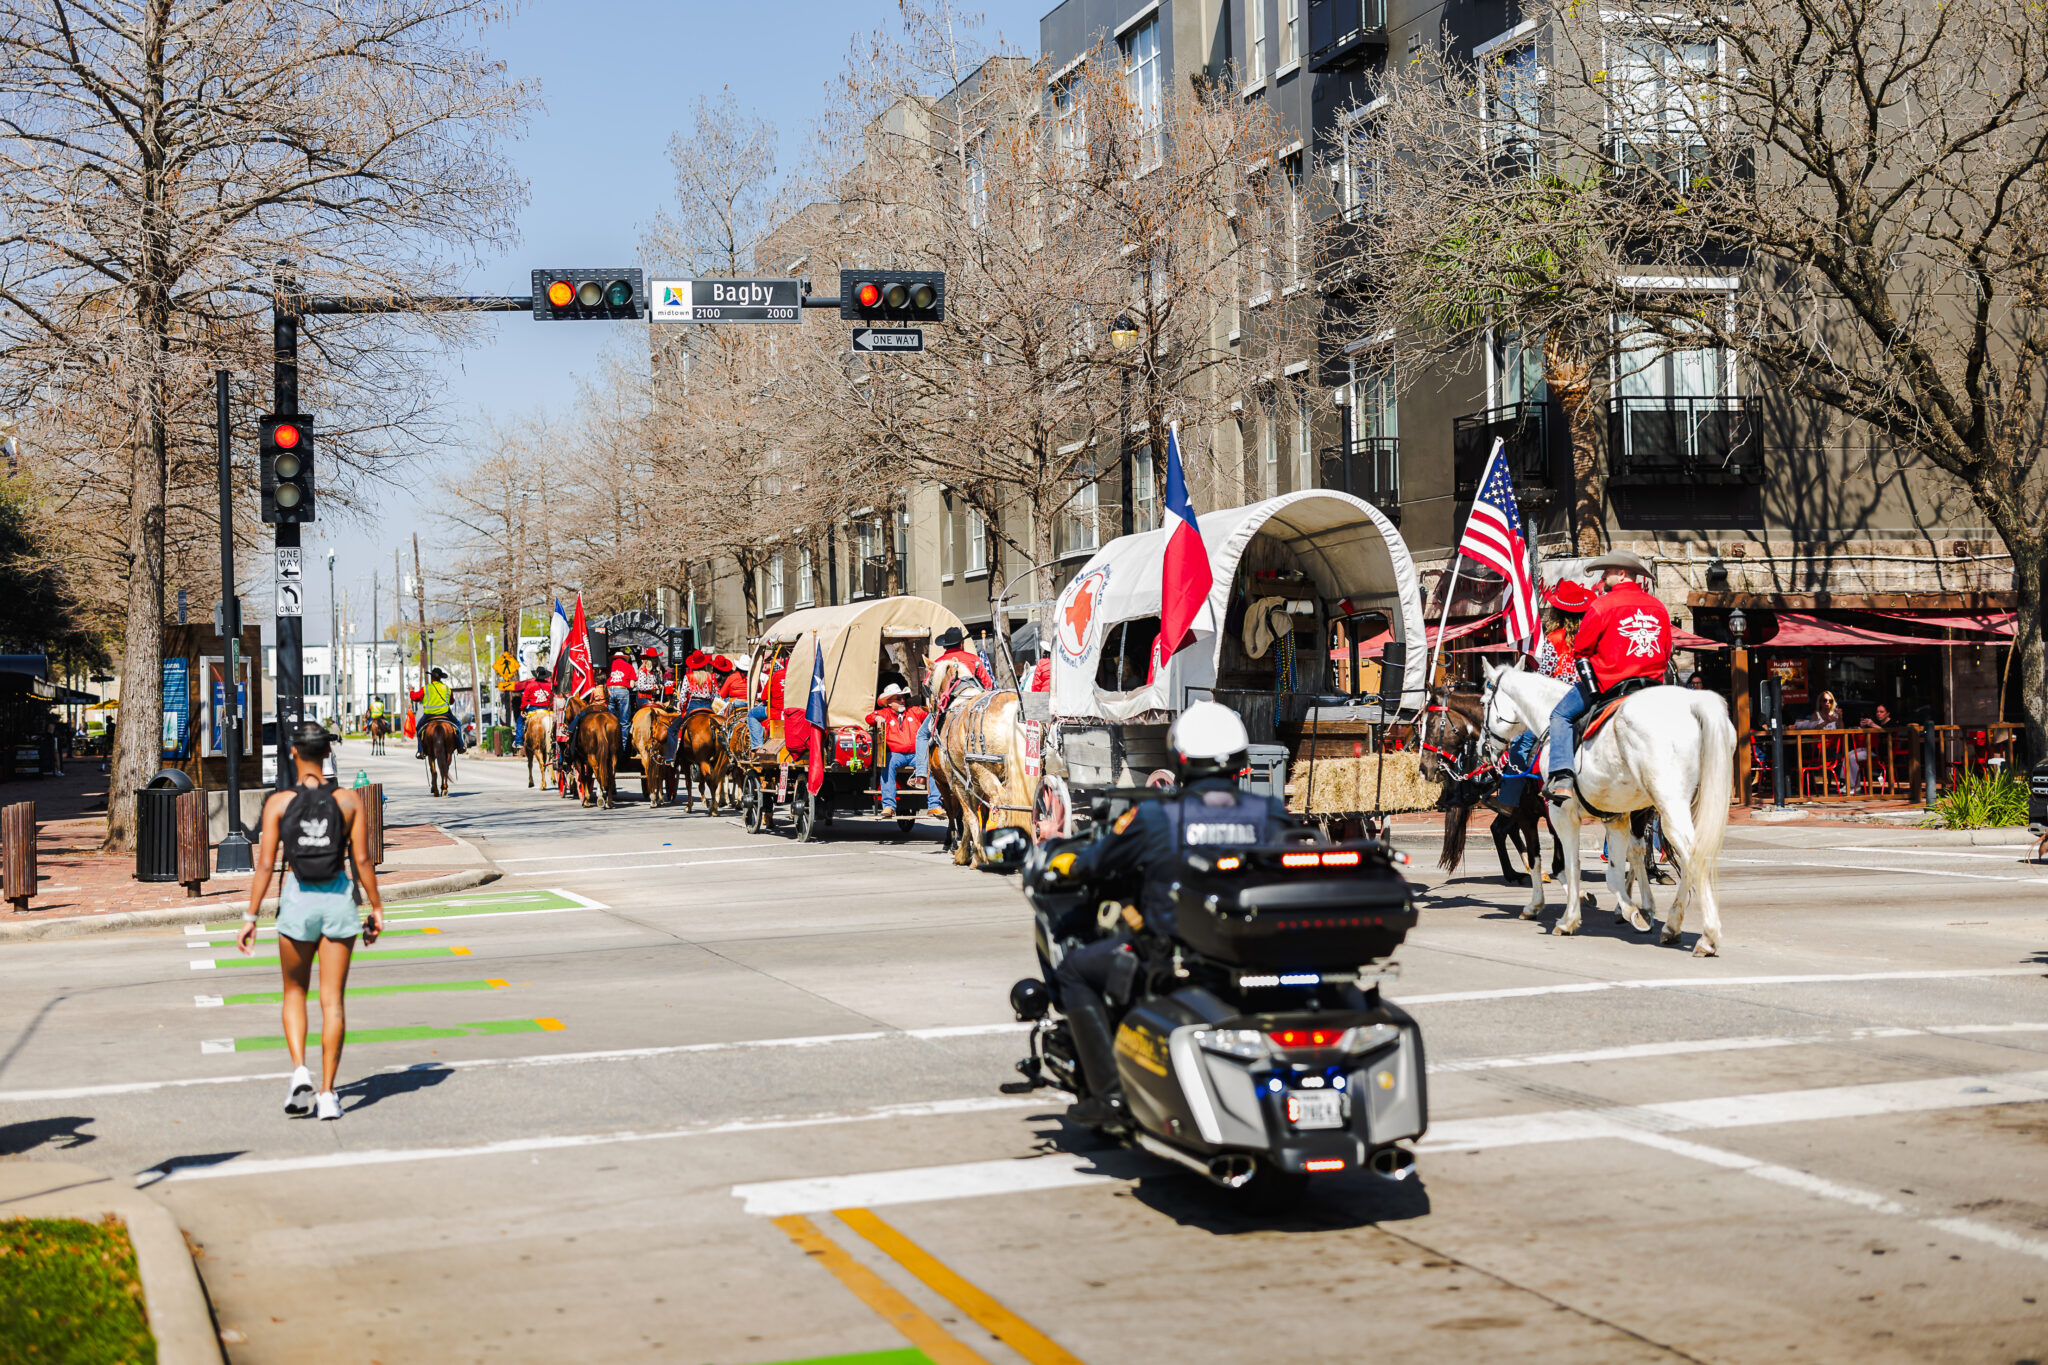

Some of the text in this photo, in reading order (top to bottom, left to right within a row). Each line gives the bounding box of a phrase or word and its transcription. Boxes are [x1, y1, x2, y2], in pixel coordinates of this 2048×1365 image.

[713, 283, 774, 306] Bagby
[696, 308, 794, 319] 2100 2000
[873, 335, 916, 345] ONE WAY
[280, 550, 299, 558] ONE
[280, 559, 299, 567] WAY
